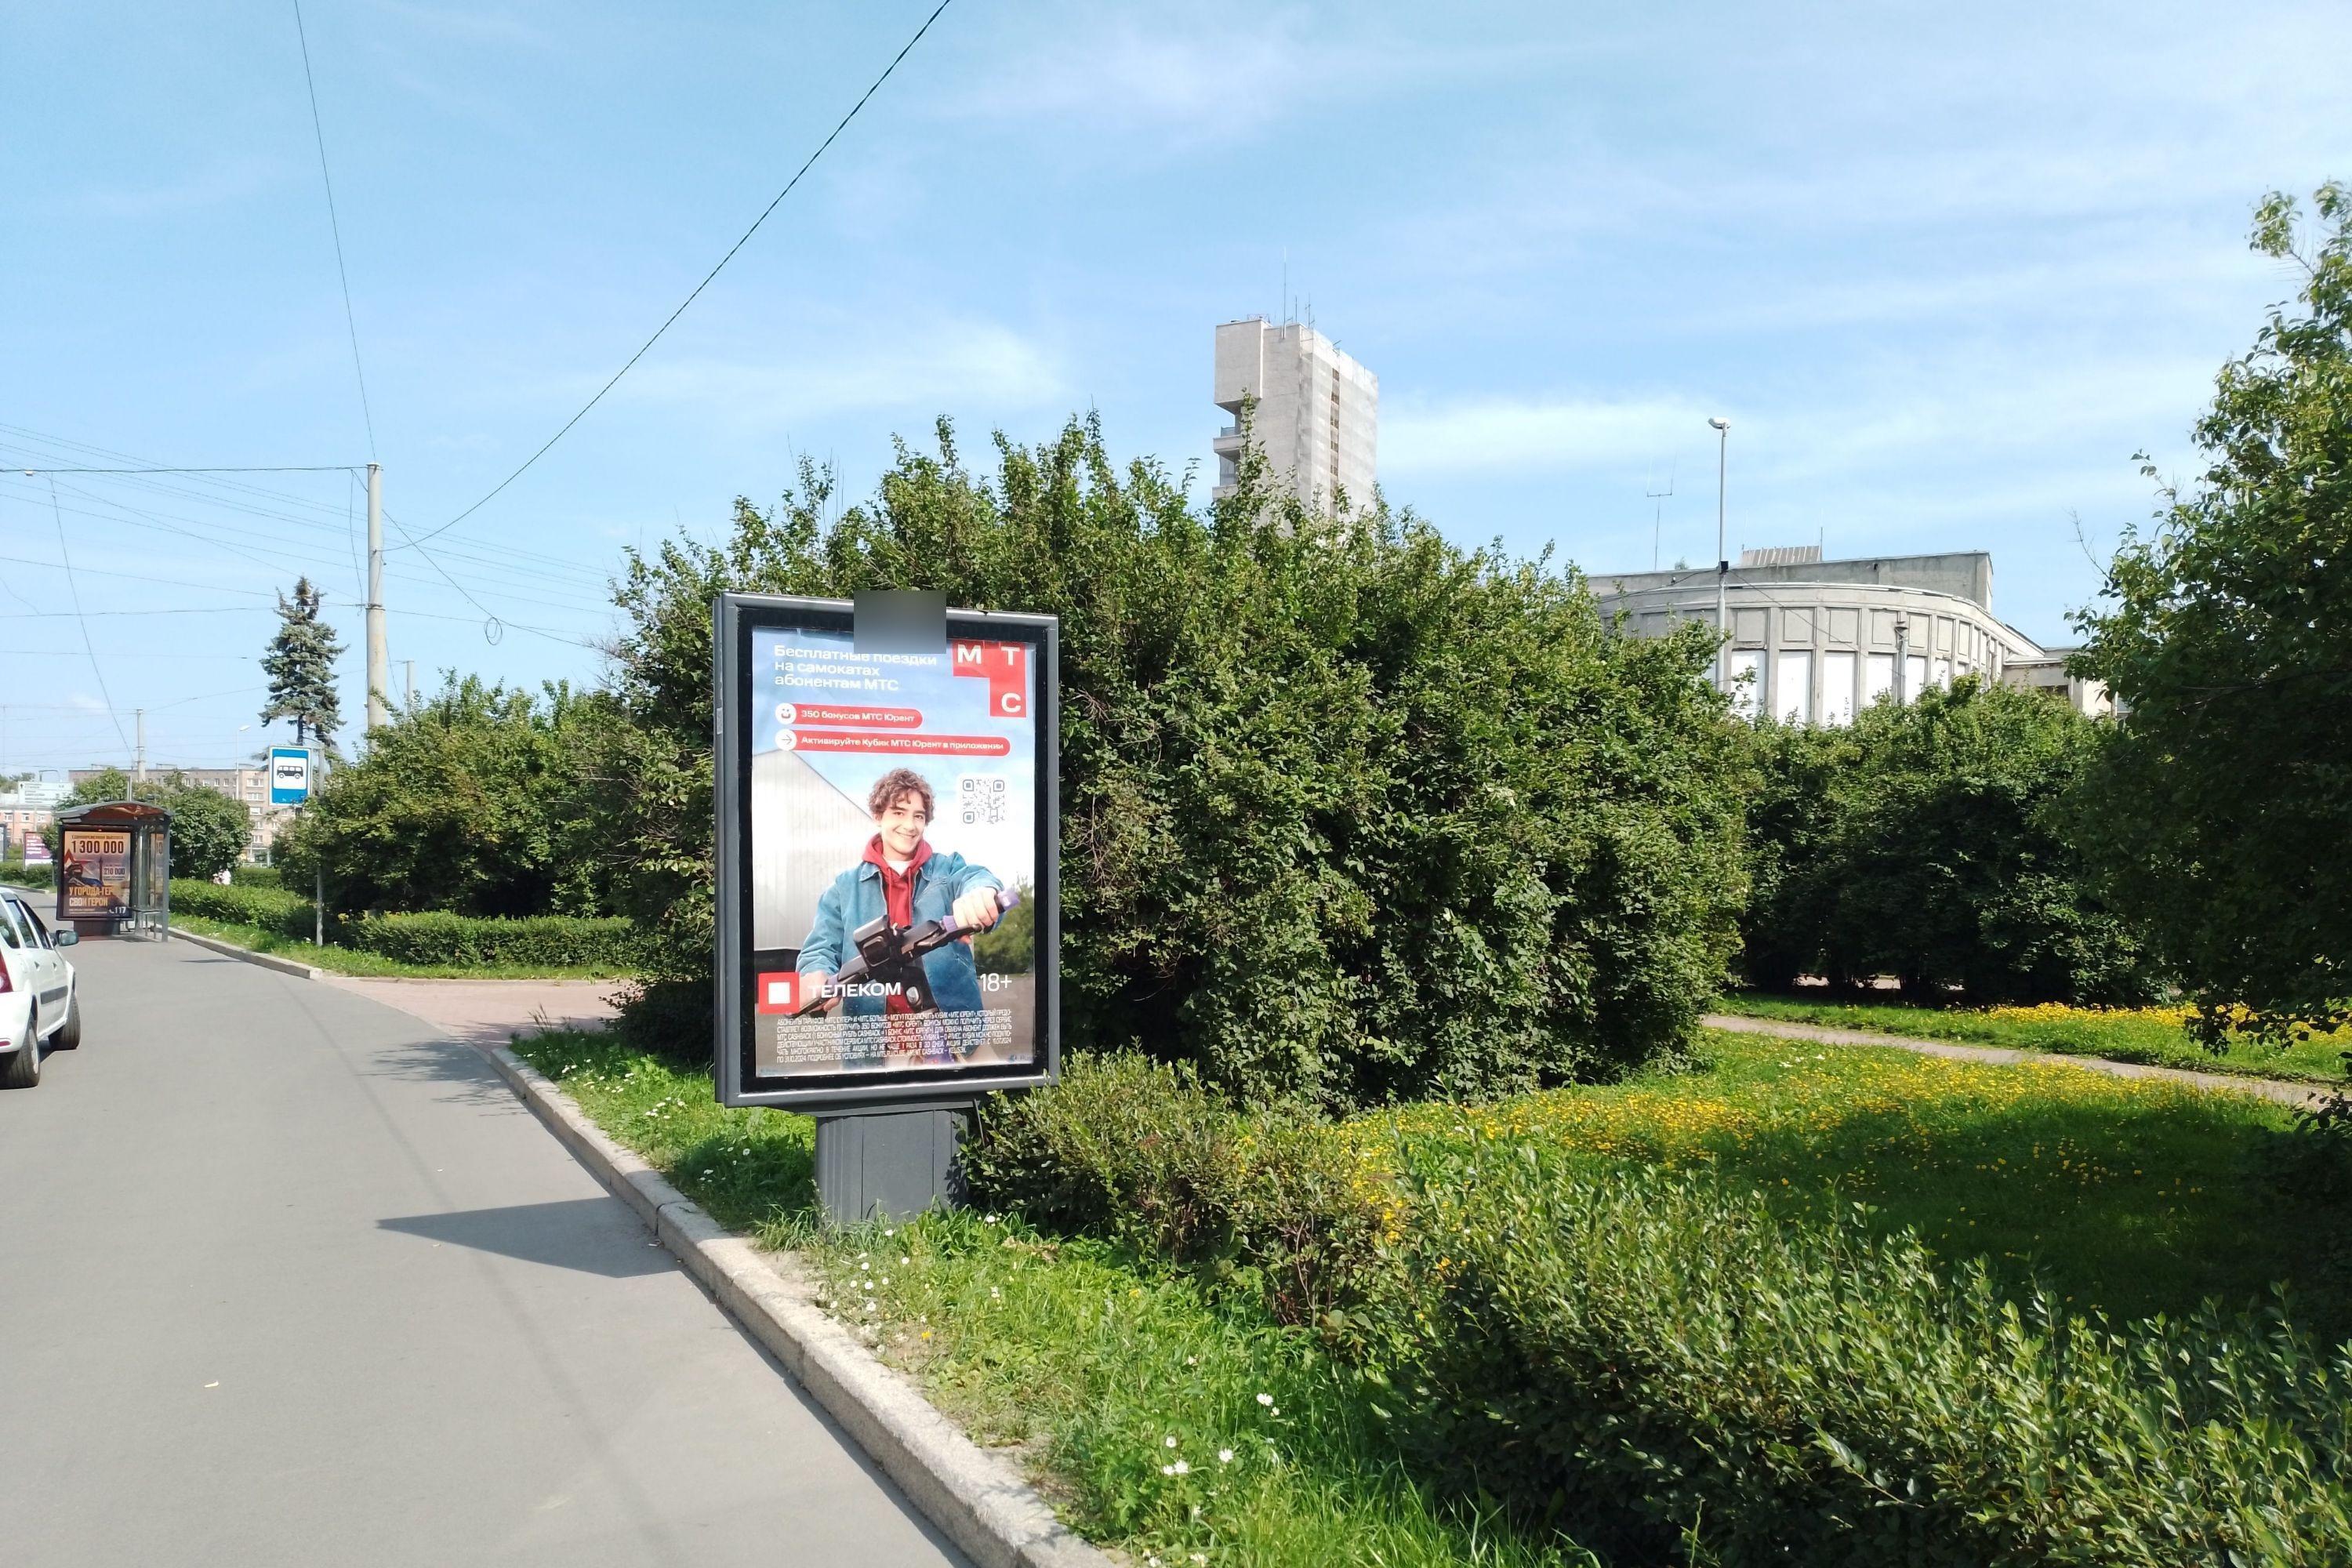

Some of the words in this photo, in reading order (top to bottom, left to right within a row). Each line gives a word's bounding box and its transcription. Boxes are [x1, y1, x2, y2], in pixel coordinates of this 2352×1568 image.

[774, 644, 870, 662] Бесплатные
[873, 654, 937, 666] поездки
[775, 661, 794, 672] на
[797, 662, 880, 677] самокатах
[775, 673, 862, 689] абонентам
[864, 678, 899, 691] МТС
[801, 710, 820, 718] 350
[821, 710, 861, 720] бонусов
[884, 713, 915, 722] Юрент
[801, 736, 861, 746] Активируйте
[862, 739, 889, 748] Кубик
[912, 740, 942, 749] Юрент
[808, 982, 902, 998] ТЕЛЕКОМ
[980, 972, 1012, 992] 18+
